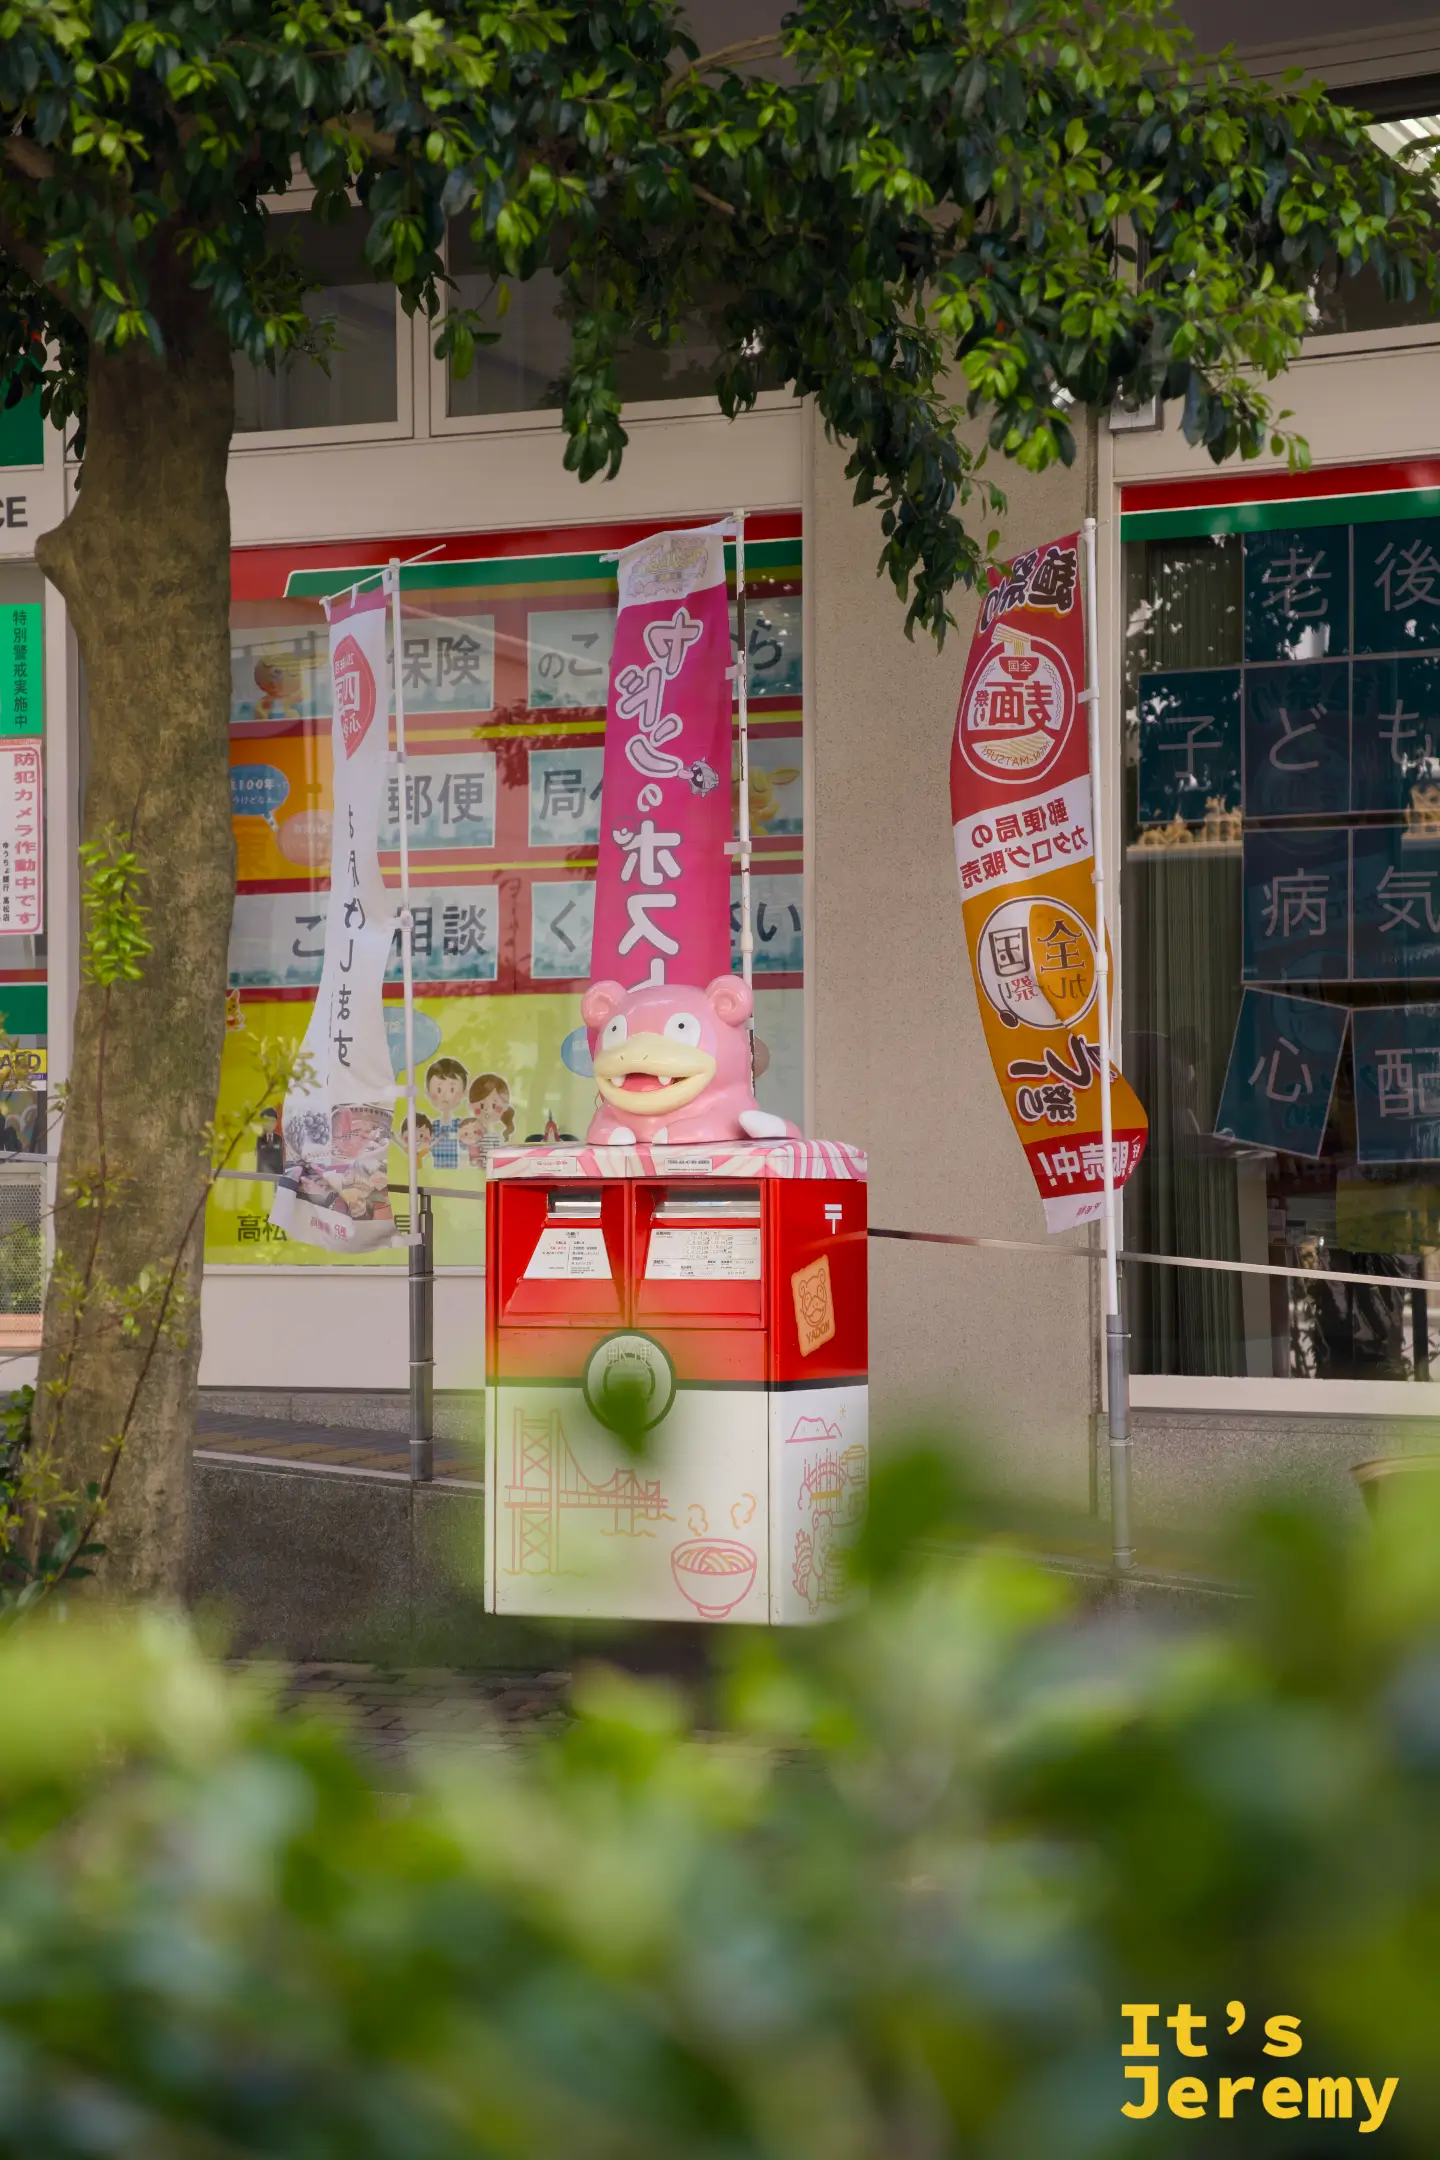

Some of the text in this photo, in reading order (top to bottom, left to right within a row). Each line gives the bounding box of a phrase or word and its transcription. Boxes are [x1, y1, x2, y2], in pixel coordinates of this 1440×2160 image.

[1262, 539, 1440, 618] 老後
[12, 610, 28, 729] 特別警戒実施中
[387, 634, 482, 689] 保険
[387, 772, 485, 826] 郵便
[13, 753, 37, 925] 防犯カメラ作動中です
[1261, 866, 1440, 937] 病気
[805, 1319, 831, 1345] YADON
